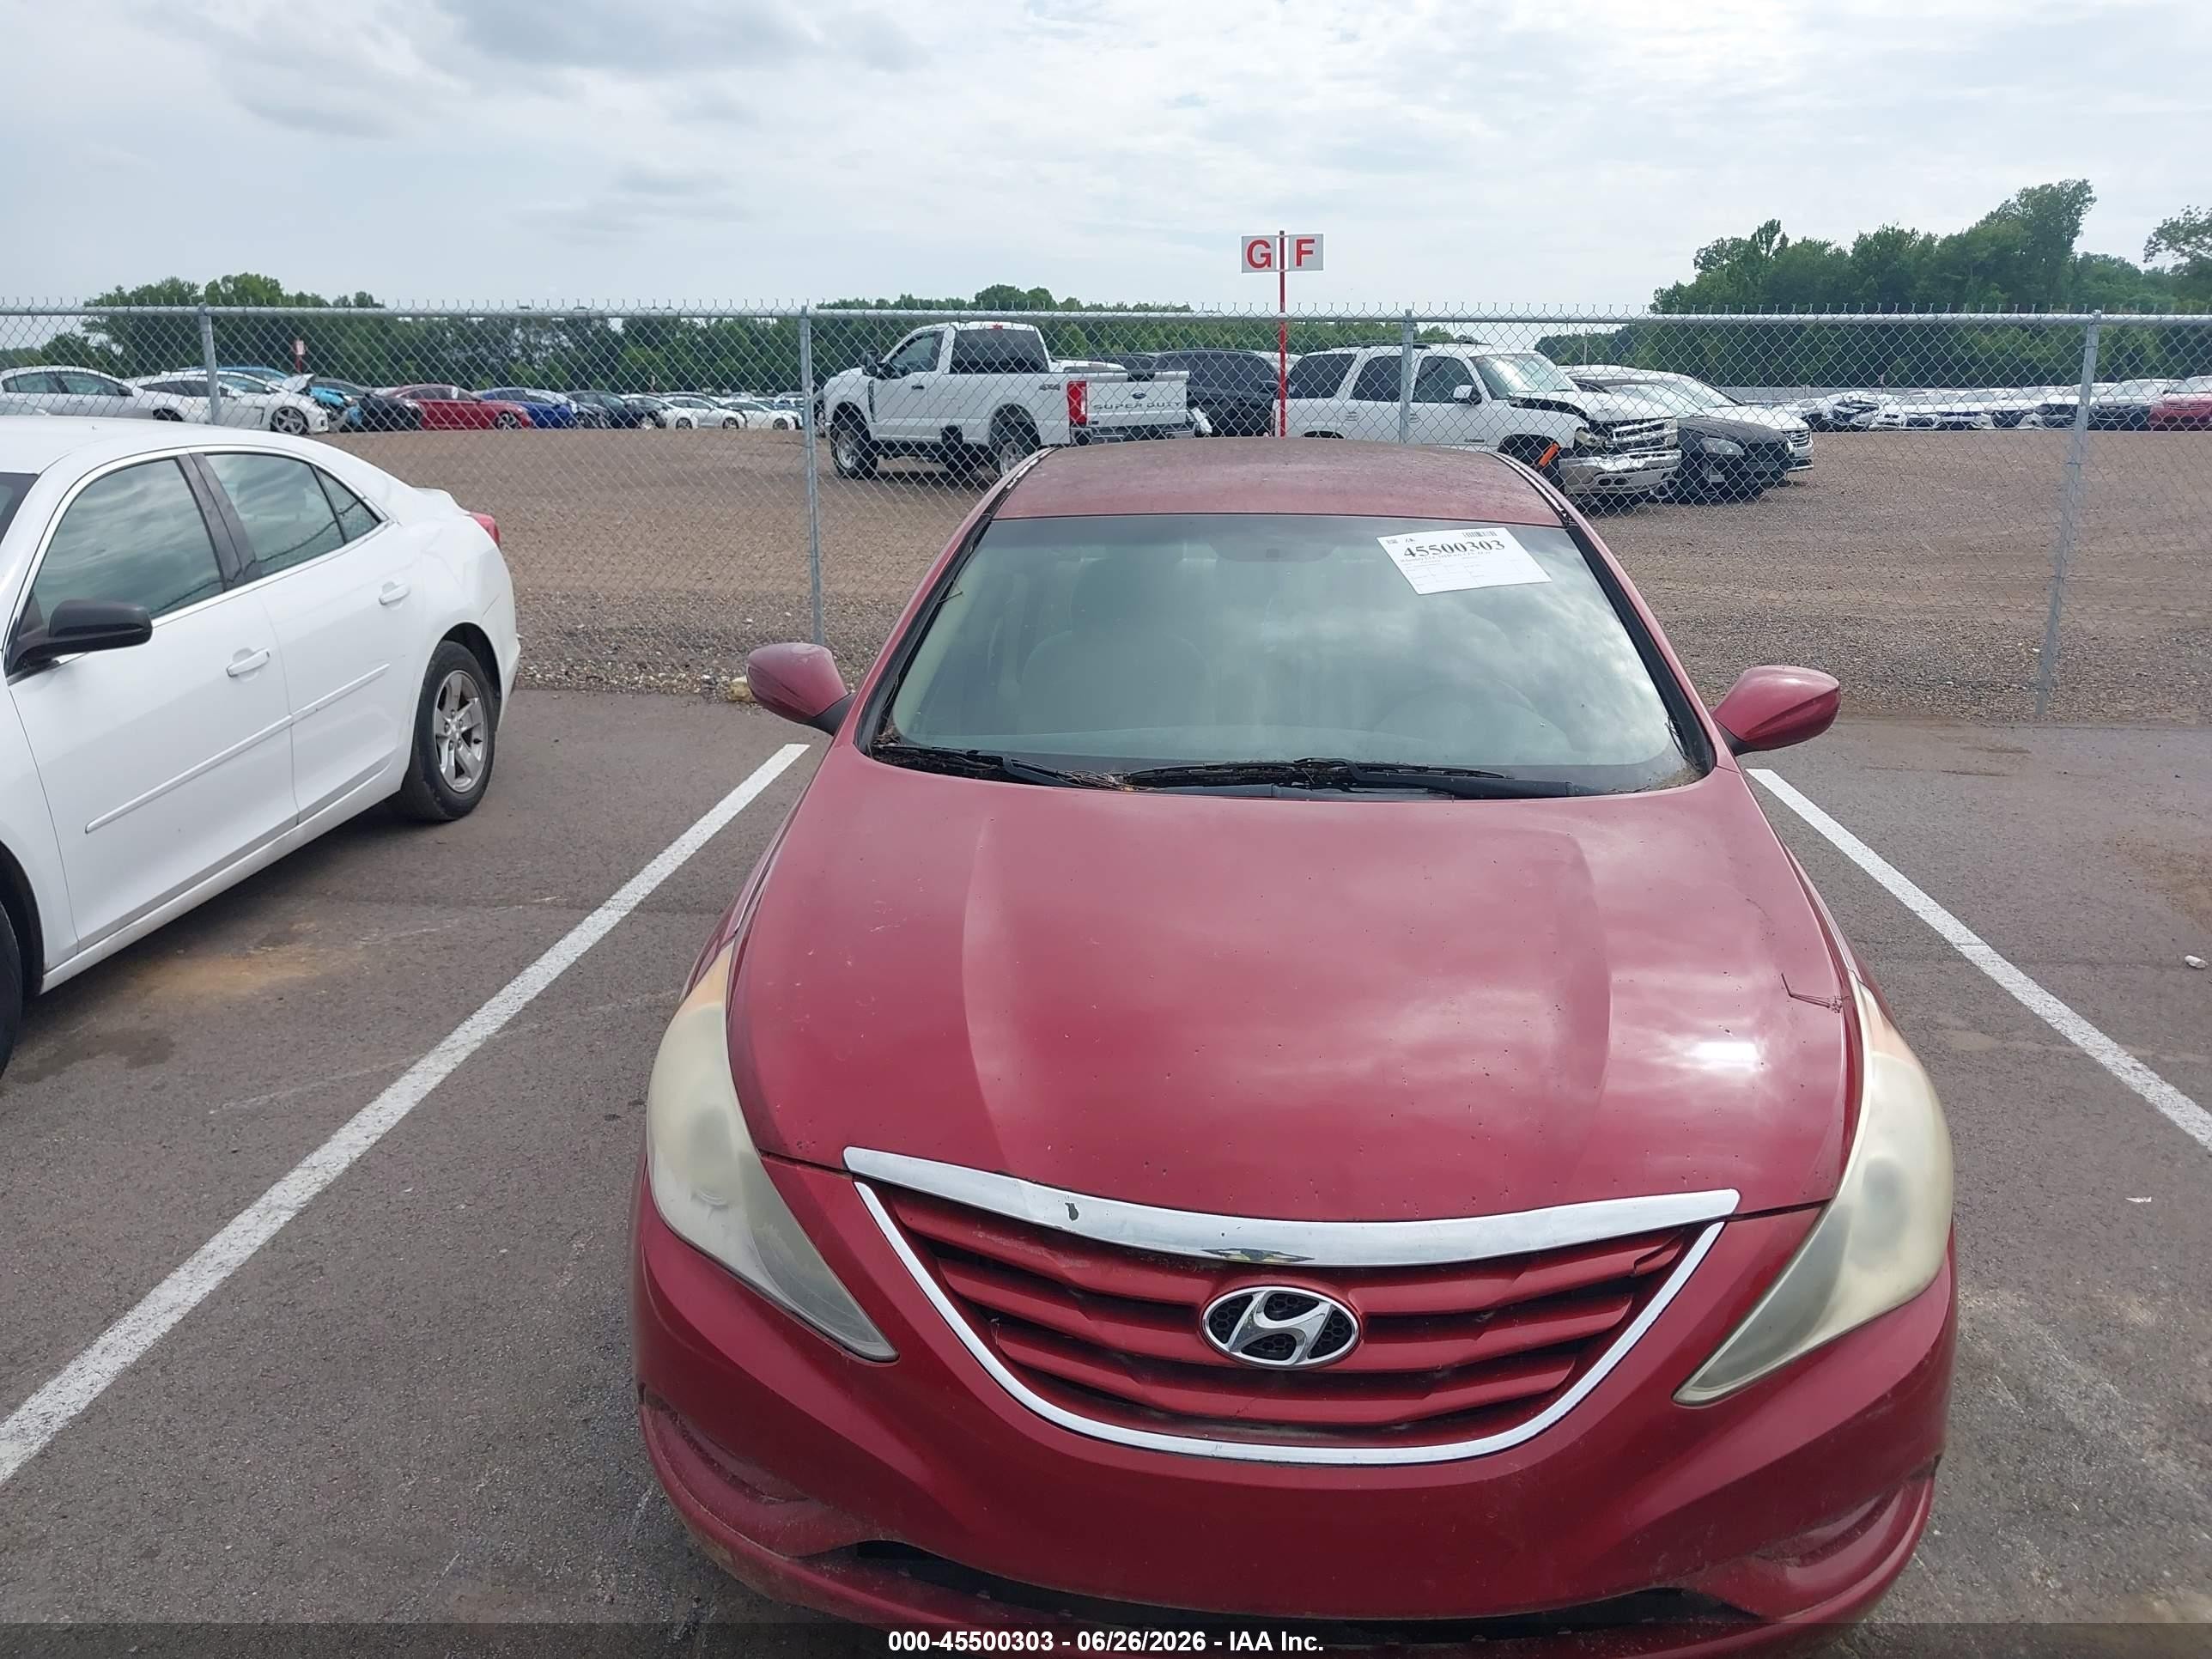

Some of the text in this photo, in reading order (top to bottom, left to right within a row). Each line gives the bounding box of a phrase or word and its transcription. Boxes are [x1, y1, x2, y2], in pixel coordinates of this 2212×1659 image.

[1247, 239, 1316, 269] G F
[1403, 539, 1505, 557] 45500303
